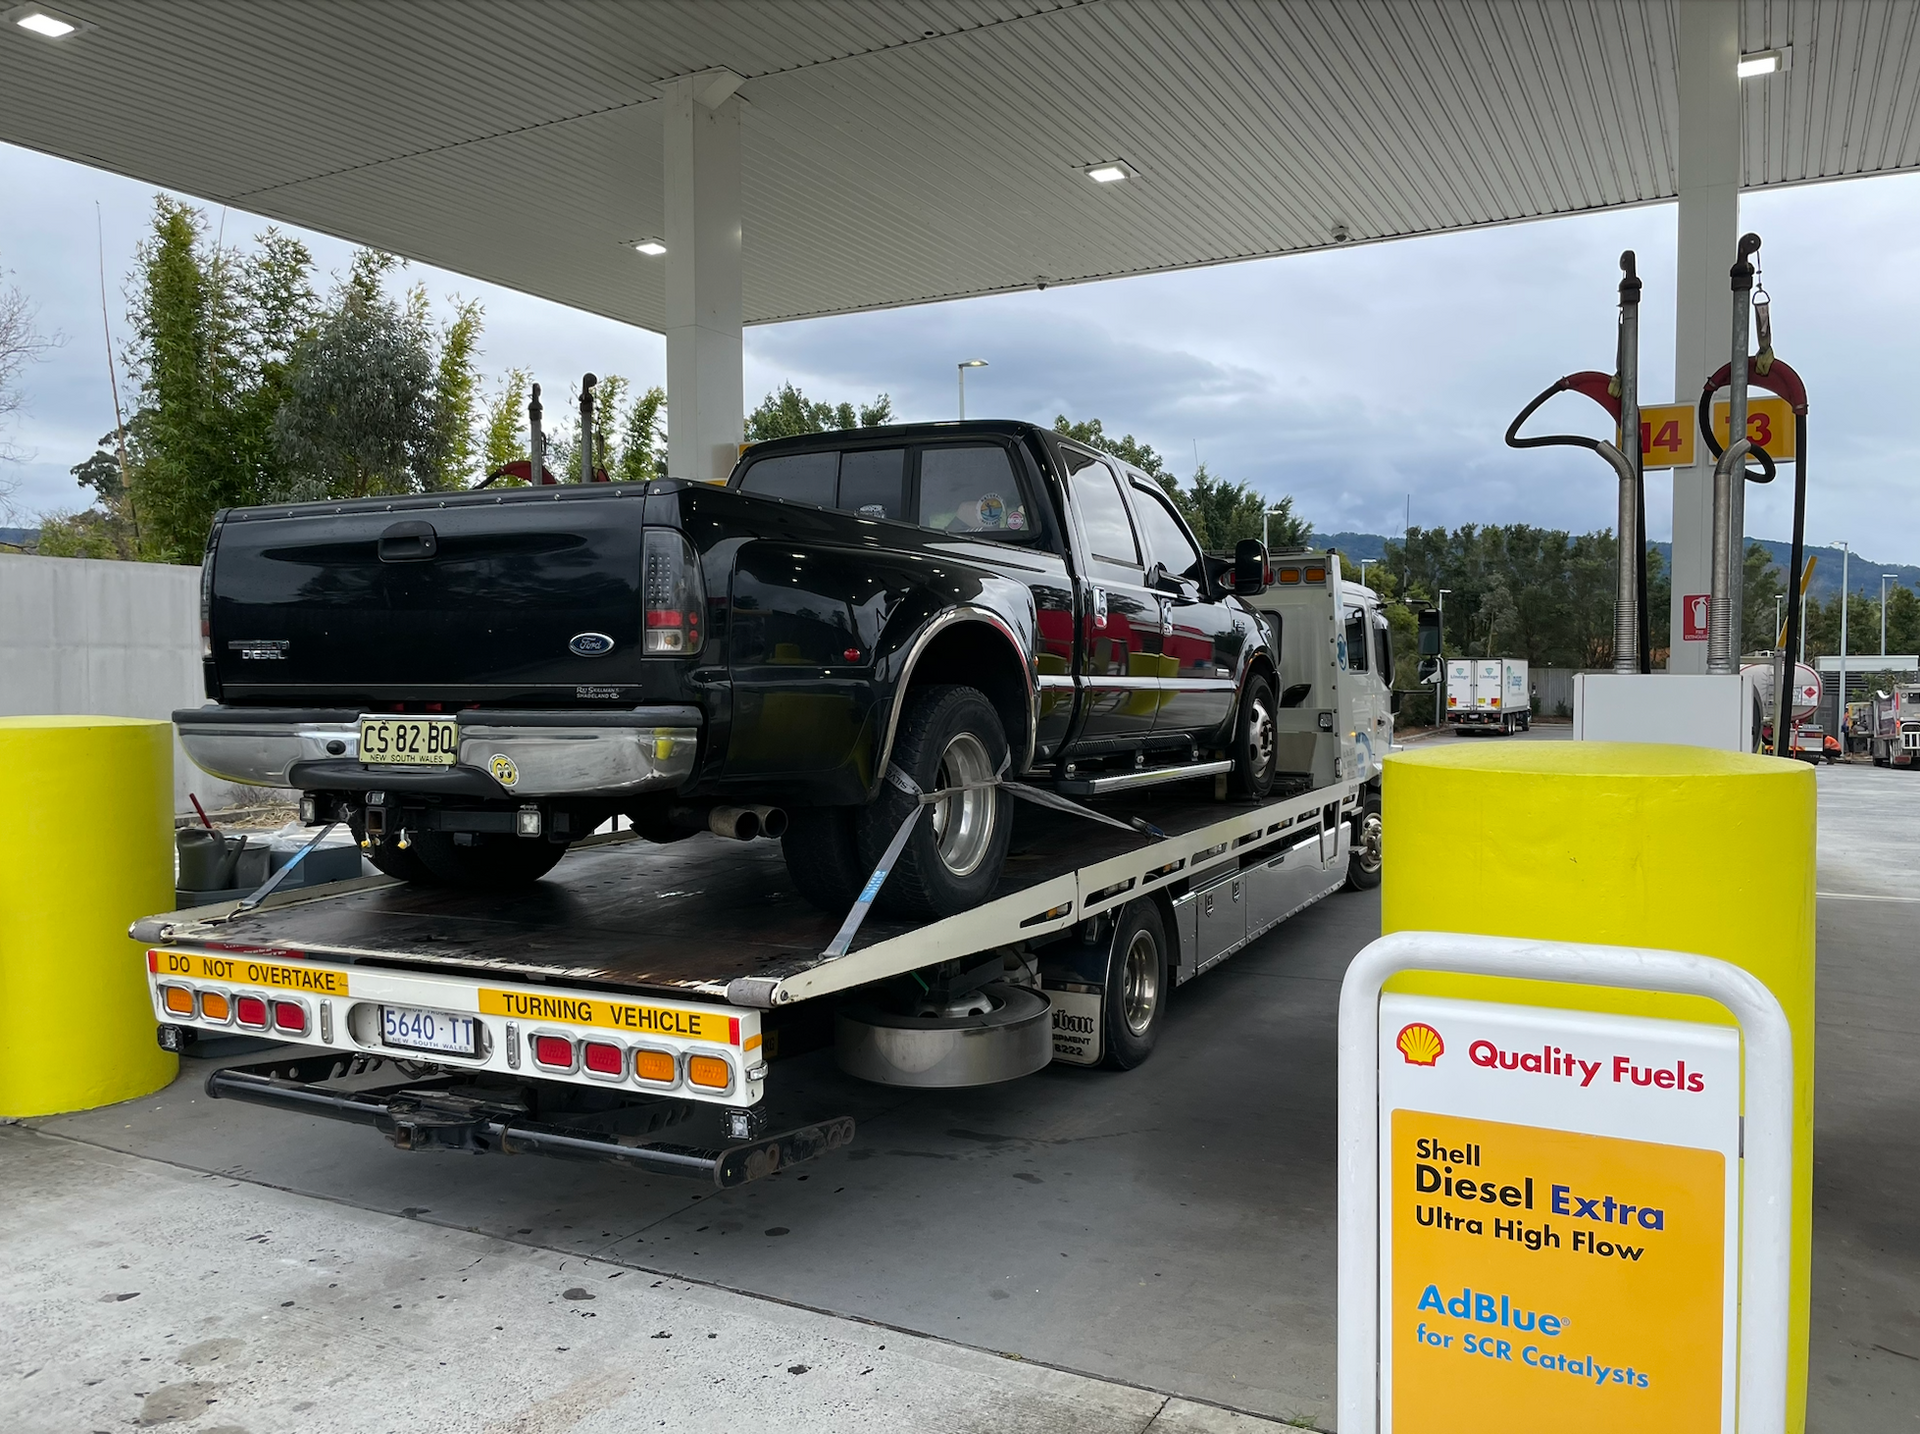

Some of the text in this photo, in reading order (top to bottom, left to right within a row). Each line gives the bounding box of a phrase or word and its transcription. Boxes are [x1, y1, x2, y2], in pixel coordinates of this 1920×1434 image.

[1725, 412, 1772, 447] 3
[242, 649, 287, 659] DIESEL
[579, 636, 602, 650] Ford
[391, 754, 416, 762] SOUTH
[419, 755, 443, 763] WALES
[169, 955, 336, 991] DO NOT OVERTAKE
[502, 994, 702, 1035] TURNING VEHICLE
[413, 1039, 439, 1048] SOUTH
[442, 1043, 469, 1052] WALES
[1468, 1039, 1705, 1093] Quality Fuels
[1416, 1138, 1480, 1167] Shell
[1416, 1163, 1664, 1231] Diesel Extra
[1416, 1204, 1645, 1262] Ultra High Flow
[1416, 1322, 1650, 1389] for SCR Catalysts
